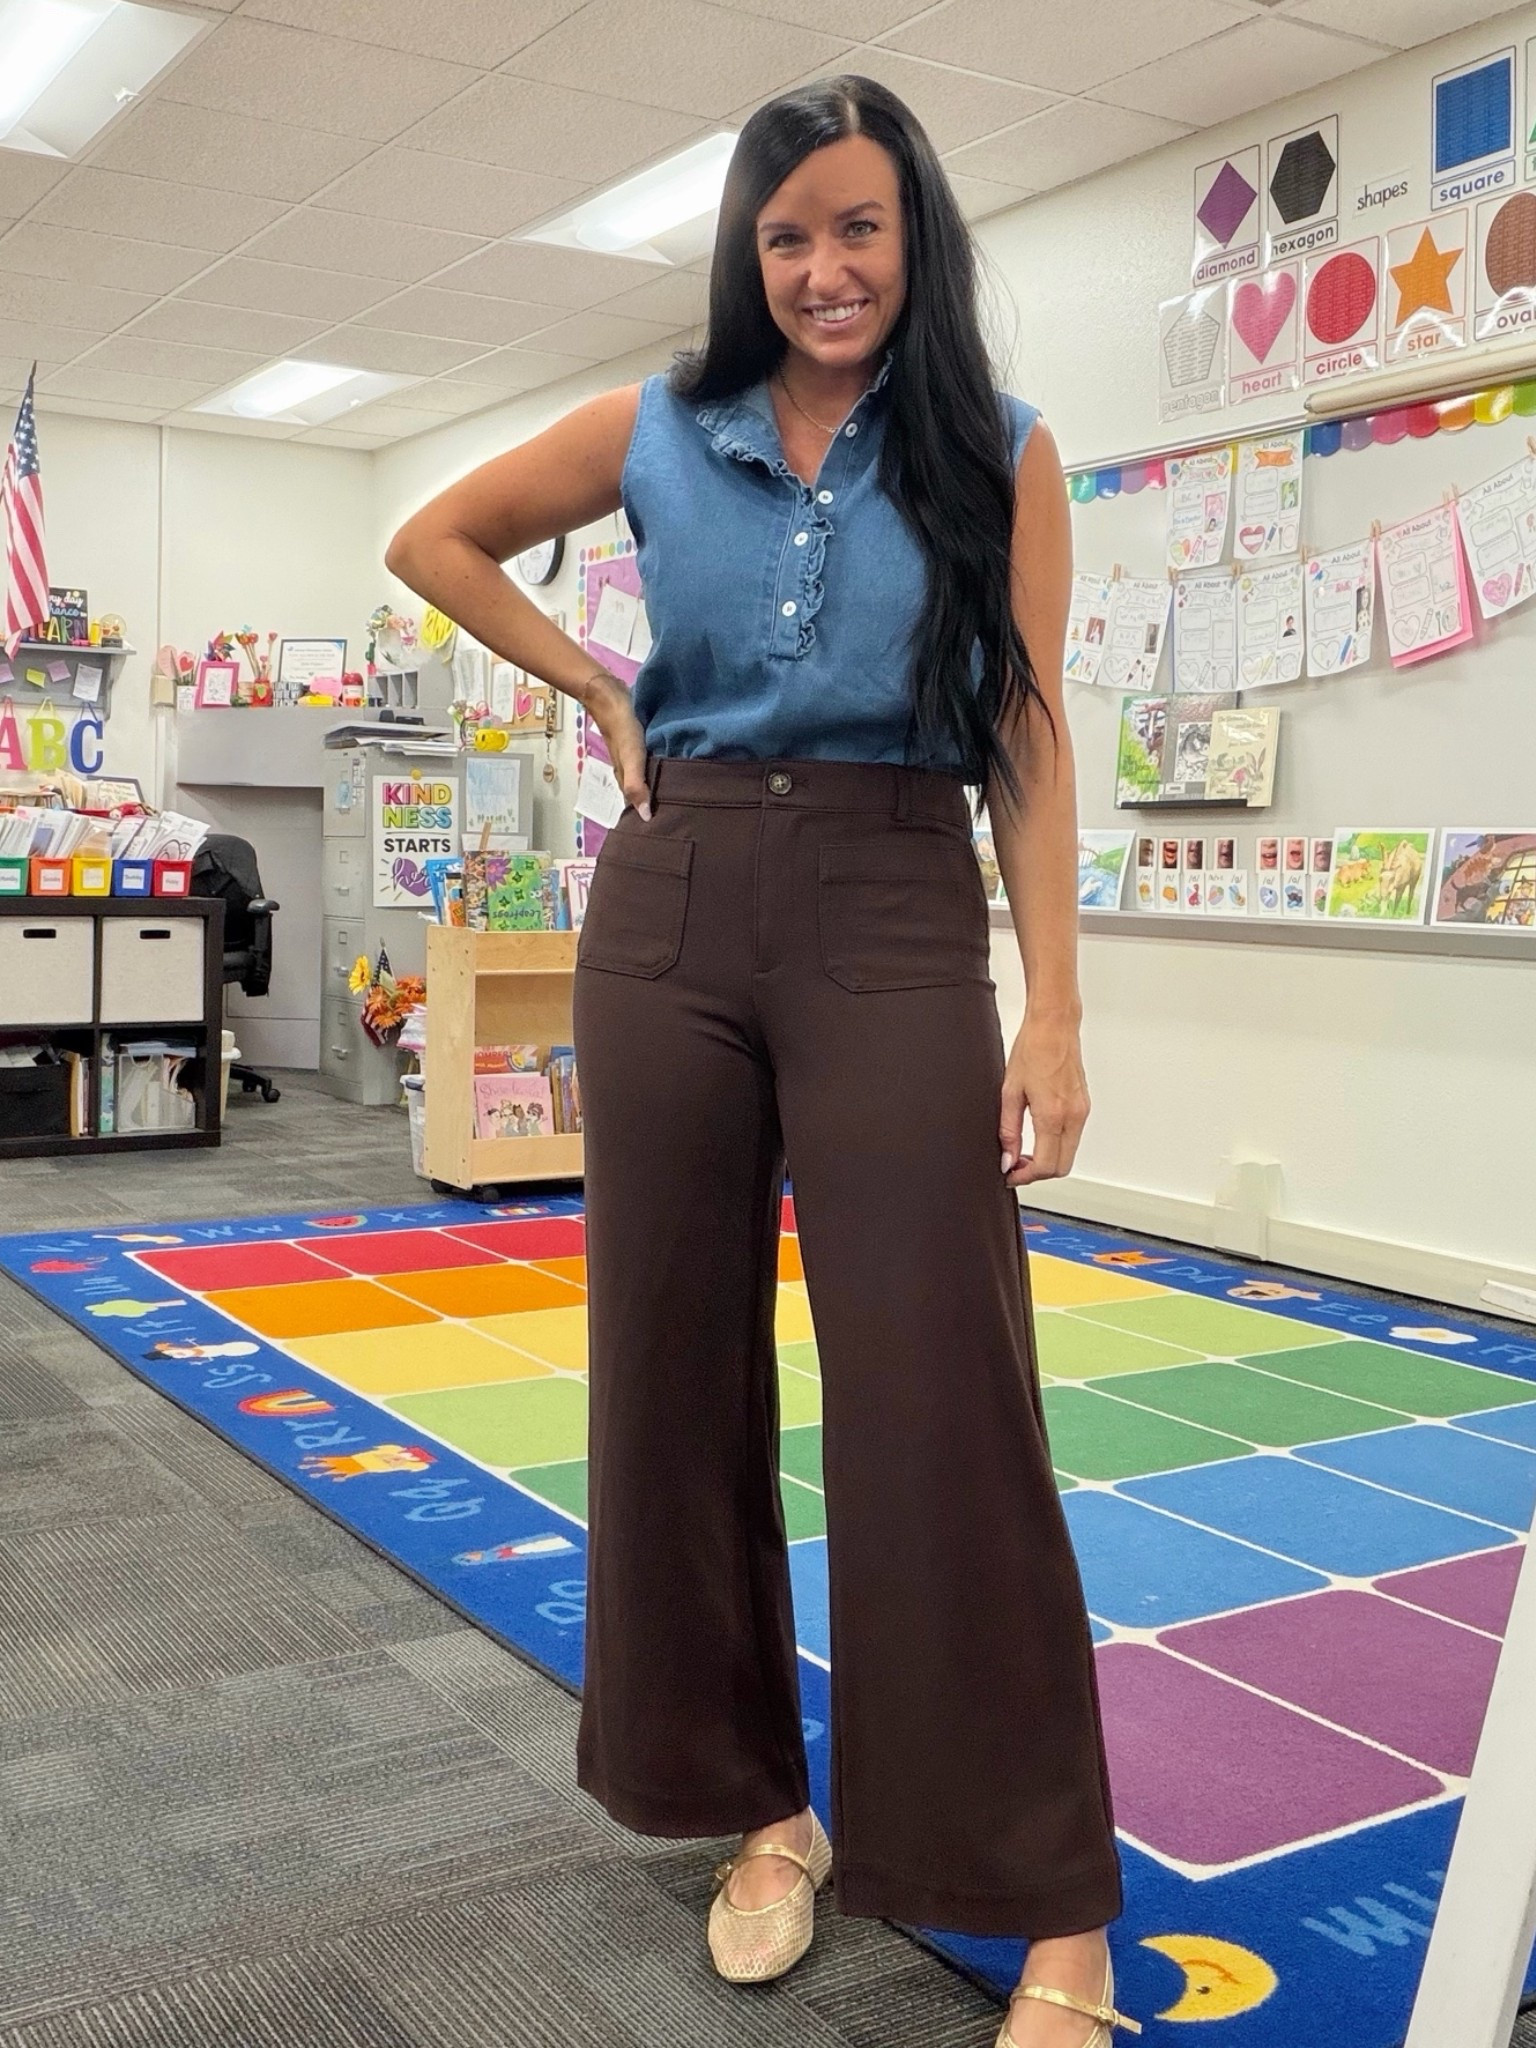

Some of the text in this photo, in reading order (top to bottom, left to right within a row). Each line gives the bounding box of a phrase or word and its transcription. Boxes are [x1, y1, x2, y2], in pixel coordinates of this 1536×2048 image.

[1357, 181, 1408, 210] shapes
[1439, 170, 1505, 201] square
[1196, 251, 1255, 281] diamond
[1407, 332, 1441, 352] star
[1316, 351, 1362, 375] circle
[1242, 371, 1282, 394] heart
[1493, 474, 1514, 488] About
[1412, 520, 1432, 532] About
[1343, 550, 1361, 561] About
[382, 782, 452, 805] KIND
[382, 806, 453, 829] NESS
[384, 838, 451, 853] STARTS
